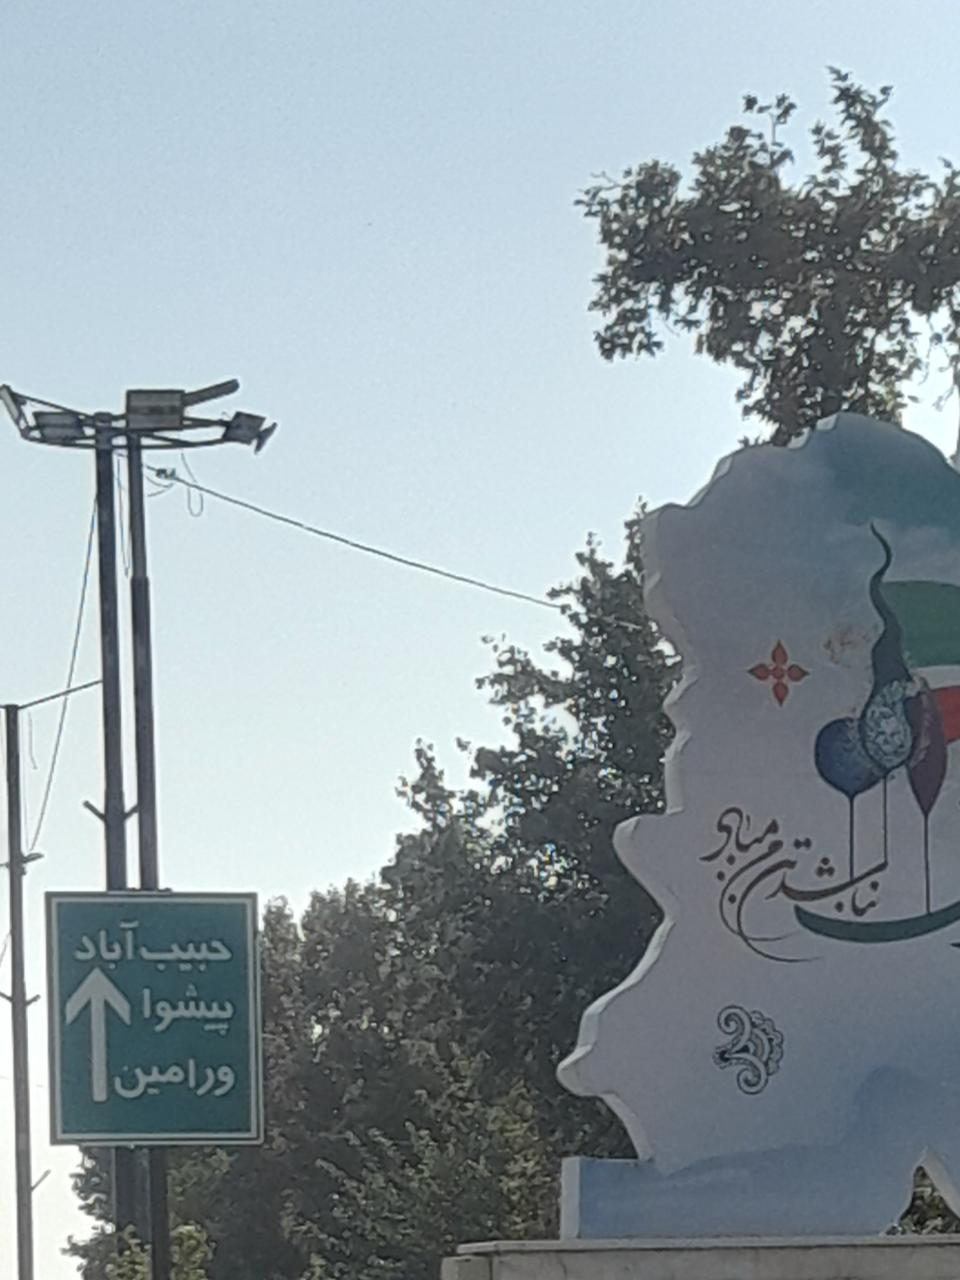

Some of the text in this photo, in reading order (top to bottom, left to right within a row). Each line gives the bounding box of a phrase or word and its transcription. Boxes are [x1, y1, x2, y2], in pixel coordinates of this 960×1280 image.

[698, 806, 780, 867] مباد
[718, 838, 802, 943] من
[736, 837, 826, 963] تن
[763, 855, 889, 918] نباشد
[74, 919, 233, 972] حبیب آباد
[142, 982, 235, 1037] پیشوا
[113, 1057, 236, 1100] ورامین
